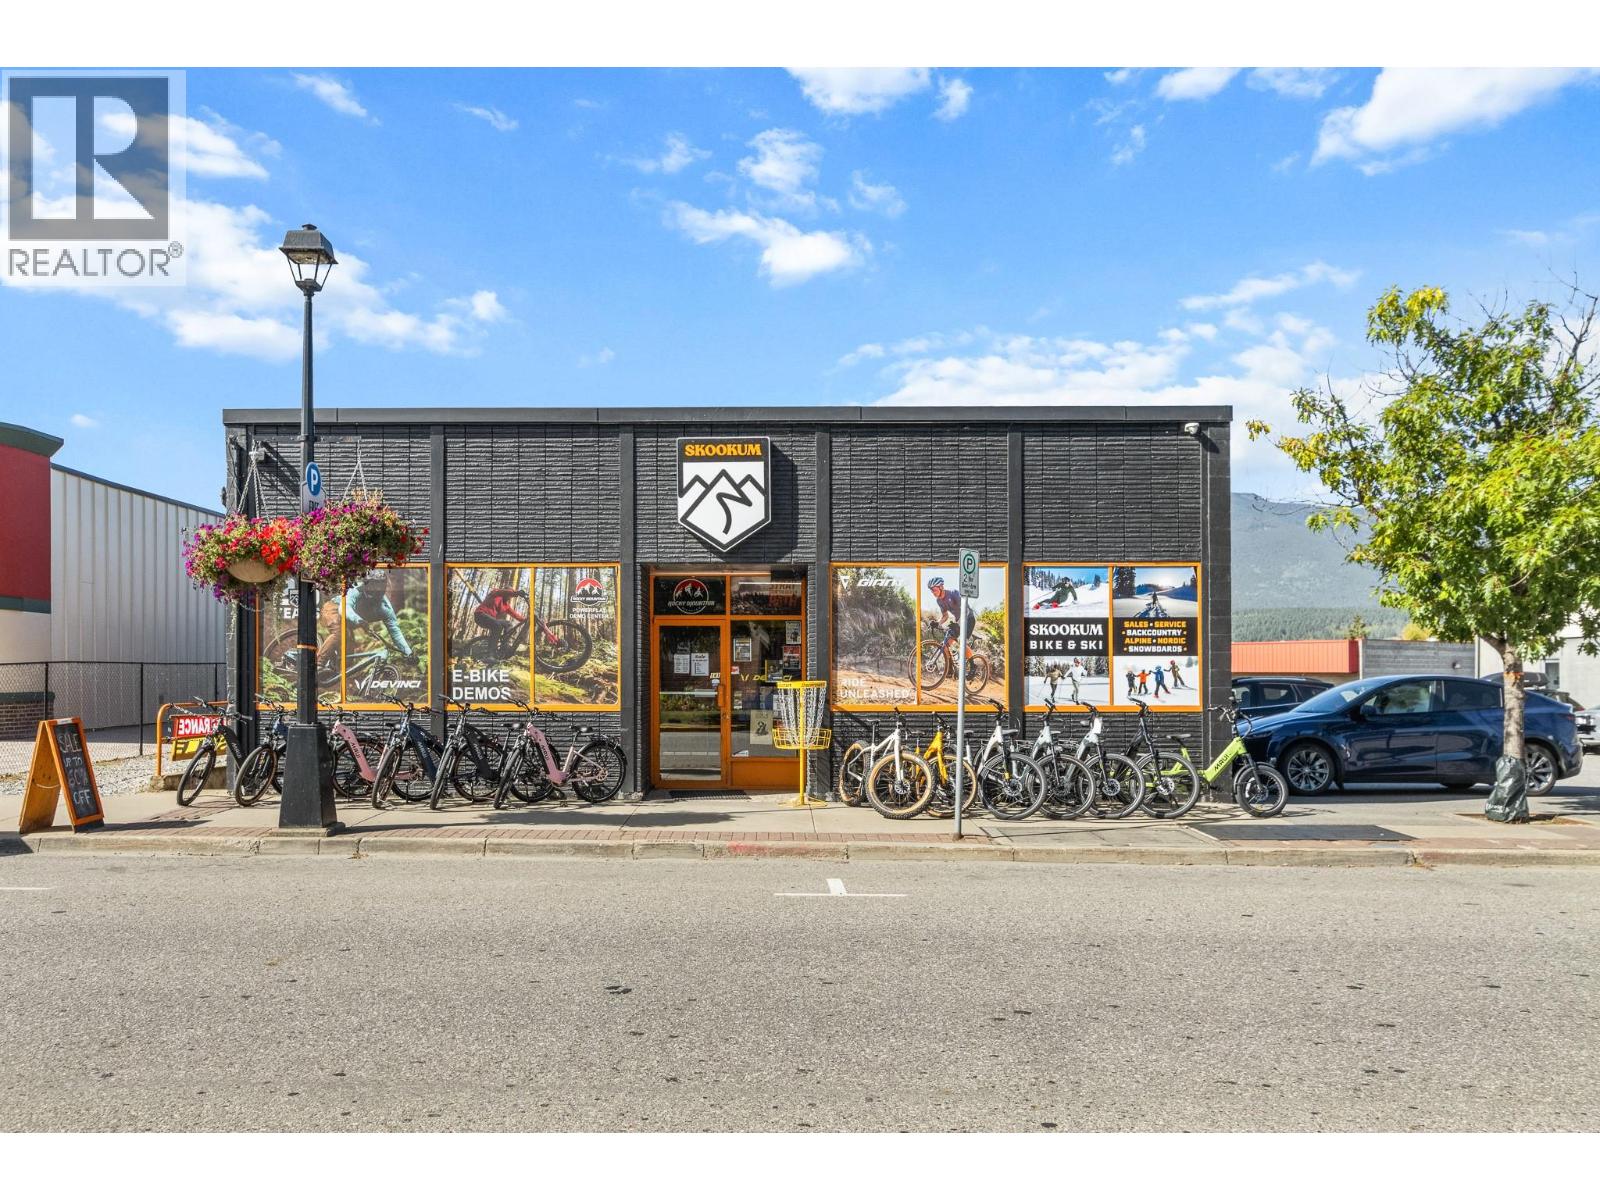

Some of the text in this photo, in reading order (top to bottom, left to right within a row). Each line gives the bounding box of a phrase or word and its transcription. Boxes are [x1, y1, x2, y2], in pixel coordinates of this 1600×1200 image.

[685, 444, 762, 456] SKOOKUM
[963, 574, 968, 583] 2
[1029, 624, 1103, 636] SKOOKUM
[1029, 640, 1103, 650] BIKE & SKI
[452, 669, 510, 682] E-BIKE
[371, 680, 421, 688] DEVINCI
[841, 679, 866, 687] RIDE
[452, 686, 511, 700] DEMOS
[841, 689, 909, 698] UNLEASHED
[59, 732, 82, 752] SALE
[73, 788, 91, 804] OFF
